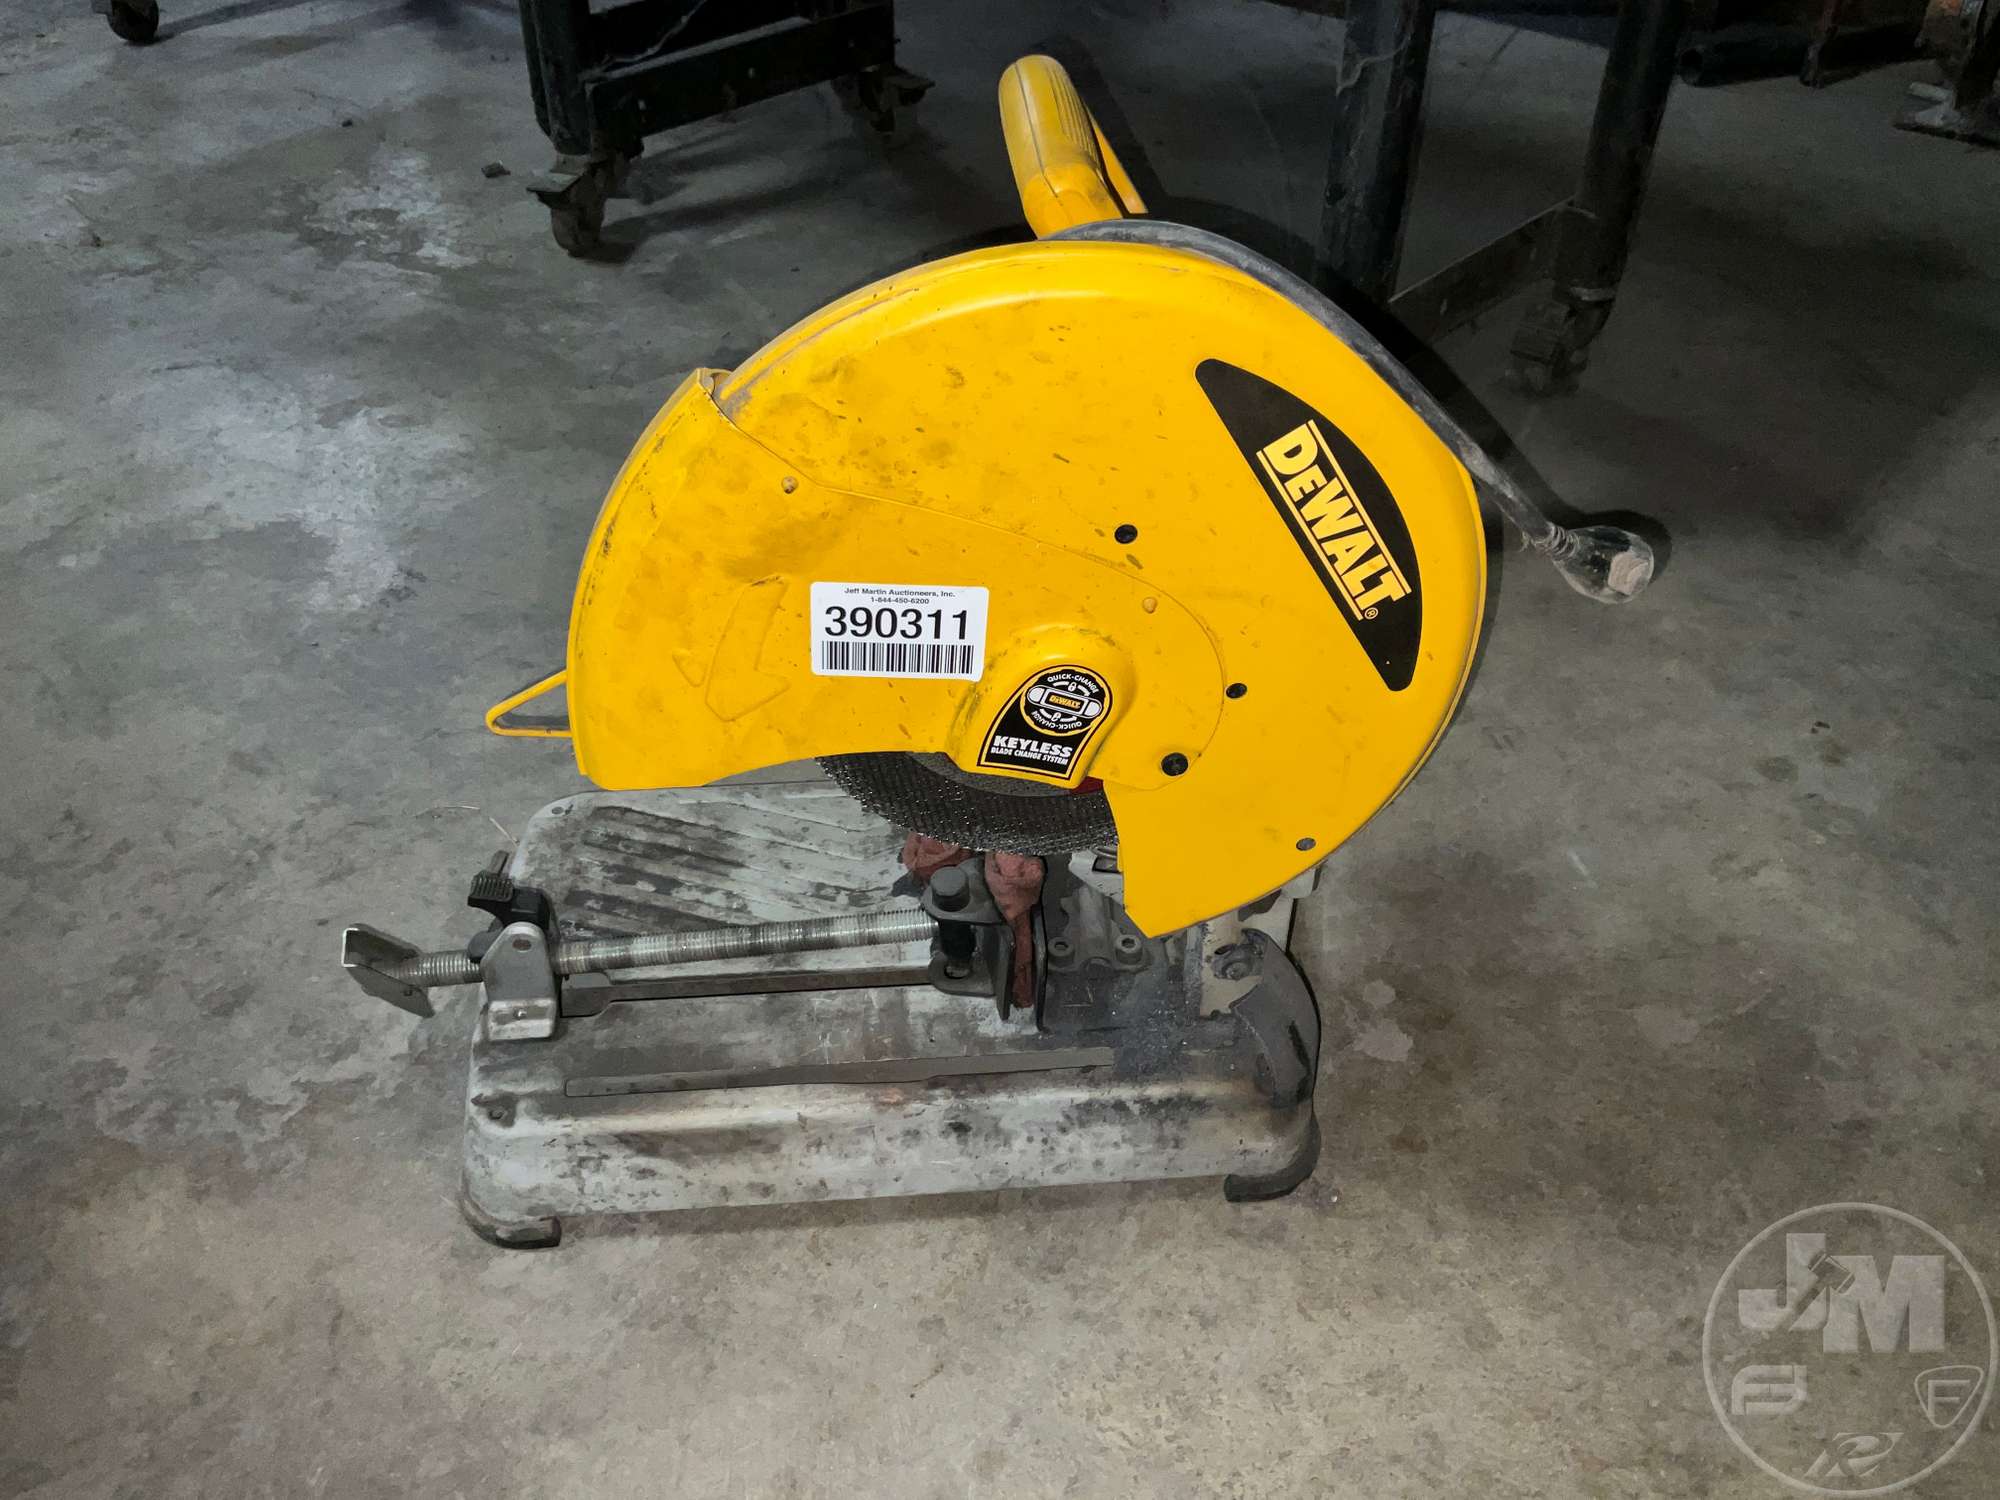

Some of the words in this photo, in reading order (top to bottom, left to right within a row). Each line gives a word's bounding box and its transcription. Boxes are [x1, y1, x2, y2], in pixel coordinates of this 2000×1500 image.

[1262, 422, 1406, 612] DEWALT
[861, 588, 887, 596] Martin
[888, 589, 940, 598] Auctioneers,
[825, 606, 968, 640] 390311
[1047, 673, 1100, 694] QUICK-CHANGE
[992, 735, 1073, 758] KEYLESS
[1014, 750, 1042, 760] CHANGE
[1042, 755, 1069, 765] SYSTEM
